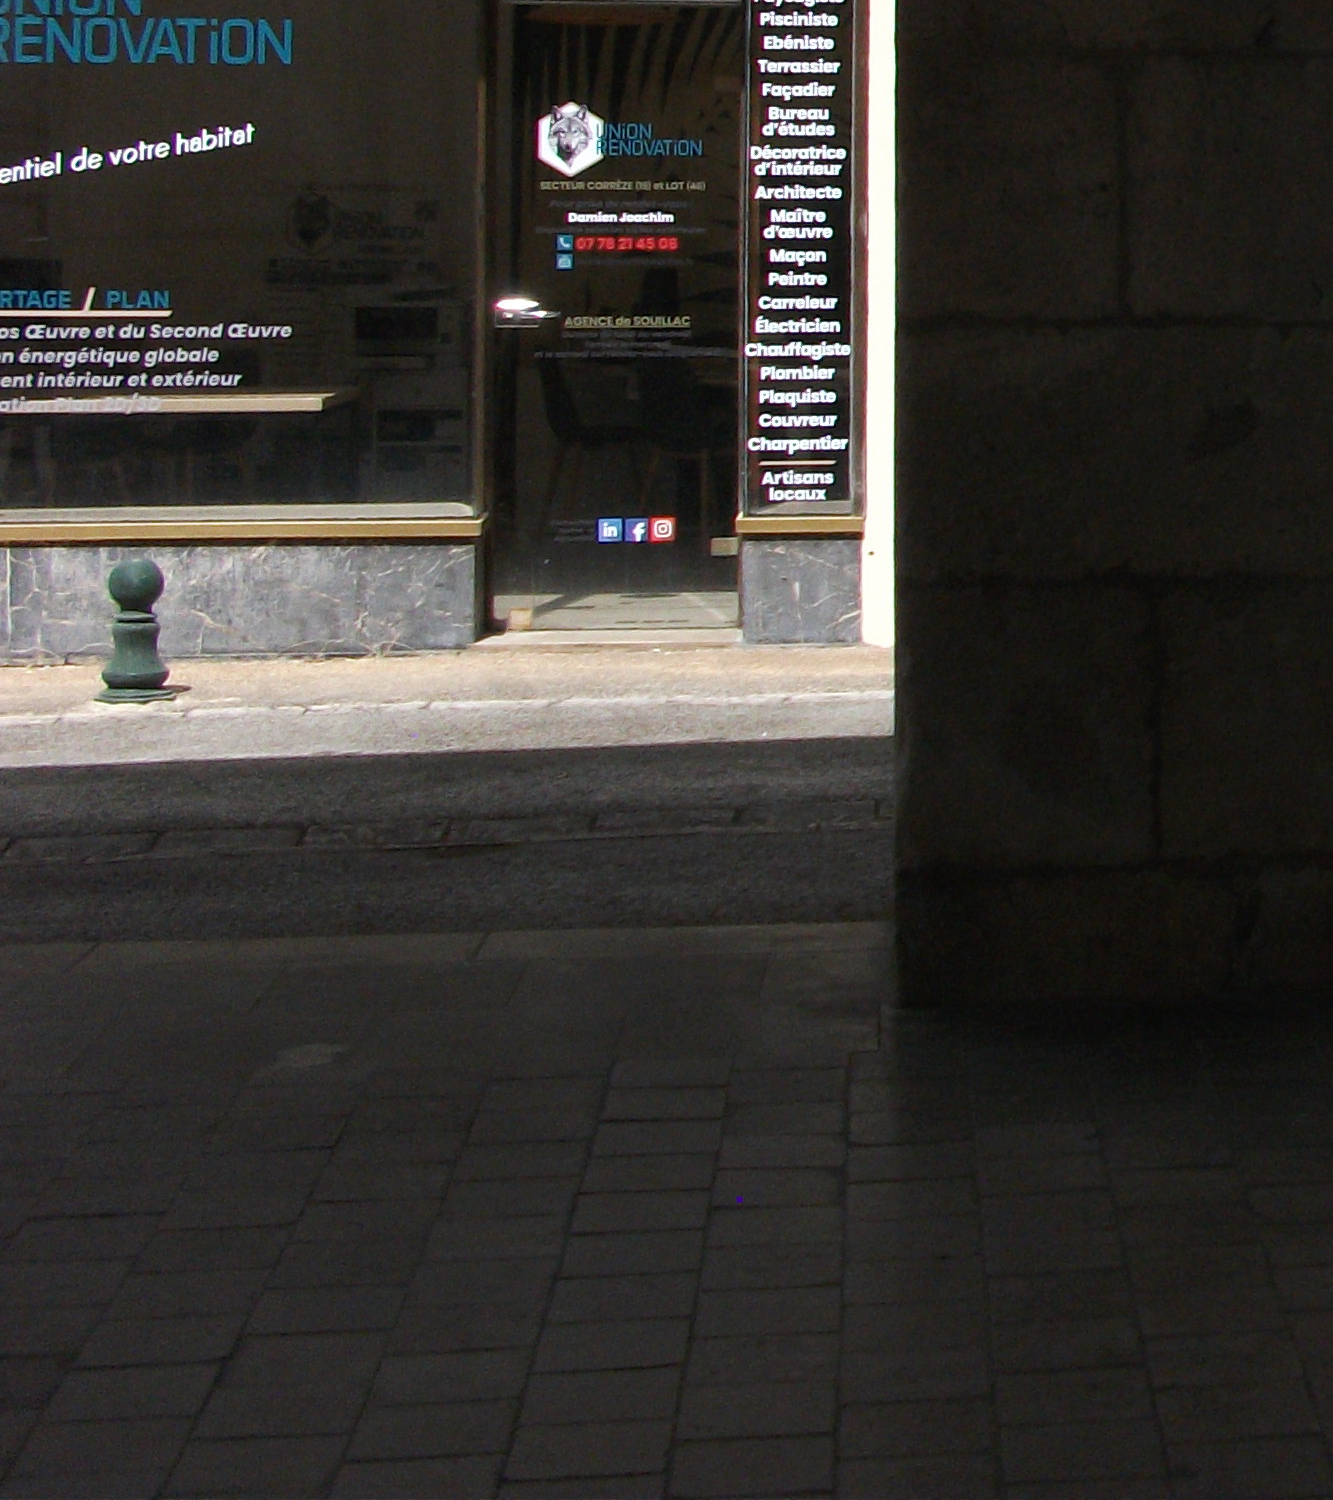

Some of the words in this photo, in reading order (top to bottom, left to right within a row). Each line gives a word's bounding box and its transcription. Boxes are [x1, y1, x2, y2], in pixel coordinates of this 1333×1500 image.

[759, 11, 839, 27] Pisciniste
[762, 34, 835, 50] Ebéniste
[757, 58, 841, 74] Terrassier
[761, 82, 836, 102] Façadier
[767, 106, 830, 121] Bureau
[762, 121, 836, 137] d'études
[70, 147, 104, 172] de
[108, 140, 171, 166] votre
[175, 123, 256, 155] habitat
[750, 144, 847, 160] Décoratrice
[754, 161, 842, 176] d'intérieur
[540, 180, 586, 191] SECTEUR
[666, 181, 684, 191] LOT
[754, 184, 843, 200] Architecte
[567, 211, 618, 223] Damien
[618, 211, 675, 223] Joachim
[769, 208, 827, 223] Maître
[576, 237, 594, 250] 07
[769, 249, 827, 267] Maçon
[768, 271, 828, 286] Peintre
[106, 290, 171, 309] PLAN
[758, 295, 838, 310] Carreleur
[564, 316, 614, 326] AGENCE
[755, 315, 841, 333] Électricien
[94, 324, 116, 339] et
[118, 323, 146, 339] du
[149, 323, 223, 339] Second
[18, 347, 140, 369] énergétique
[144, 347, 219, 368] globale
[744, 341, 851, 360] Chauffagiste
[37, 371, 124, 388] intérieur
[127, 372, 149, 388] et
[151, 370, 243, 388] extérieur
[760, 366, 836, 381] Plombier
[758, 388, 837, 407] Plaquiste
[758, 413, 838, 428] Couvreur
[748, 435, 849, 455] Charpentier
[761, 470, 834, 486] Artisans
[768, 487, 827, 501] locaux
